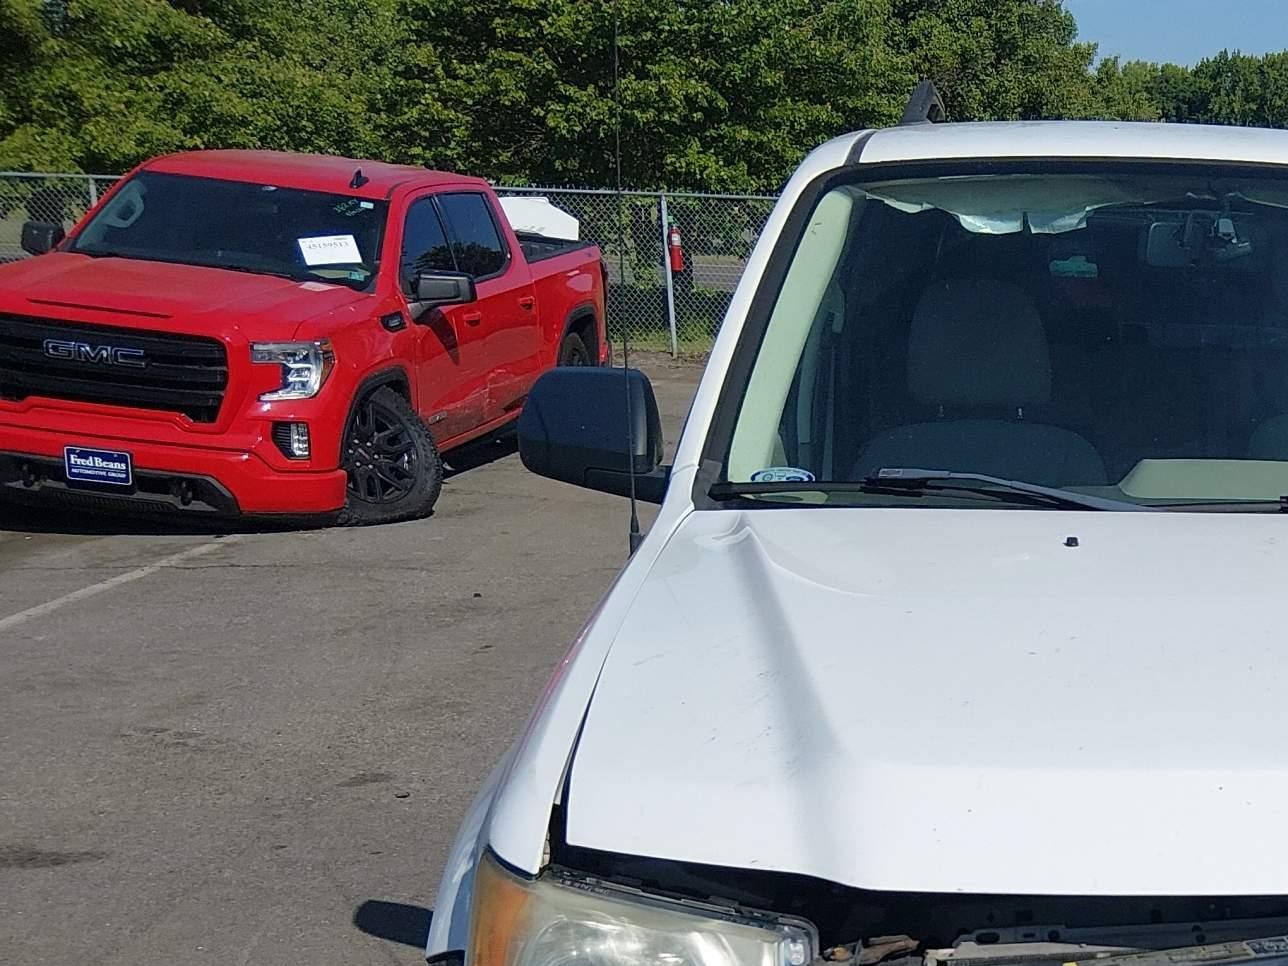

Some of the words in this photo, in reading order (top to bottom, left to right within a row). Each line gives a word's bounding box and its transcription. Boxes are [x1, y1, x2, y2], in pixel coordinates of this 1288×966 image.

[43, 339, 146, 368] GMC
[70, 454, 93, 466] Fred
[94, 457, 126, 470] Beans
